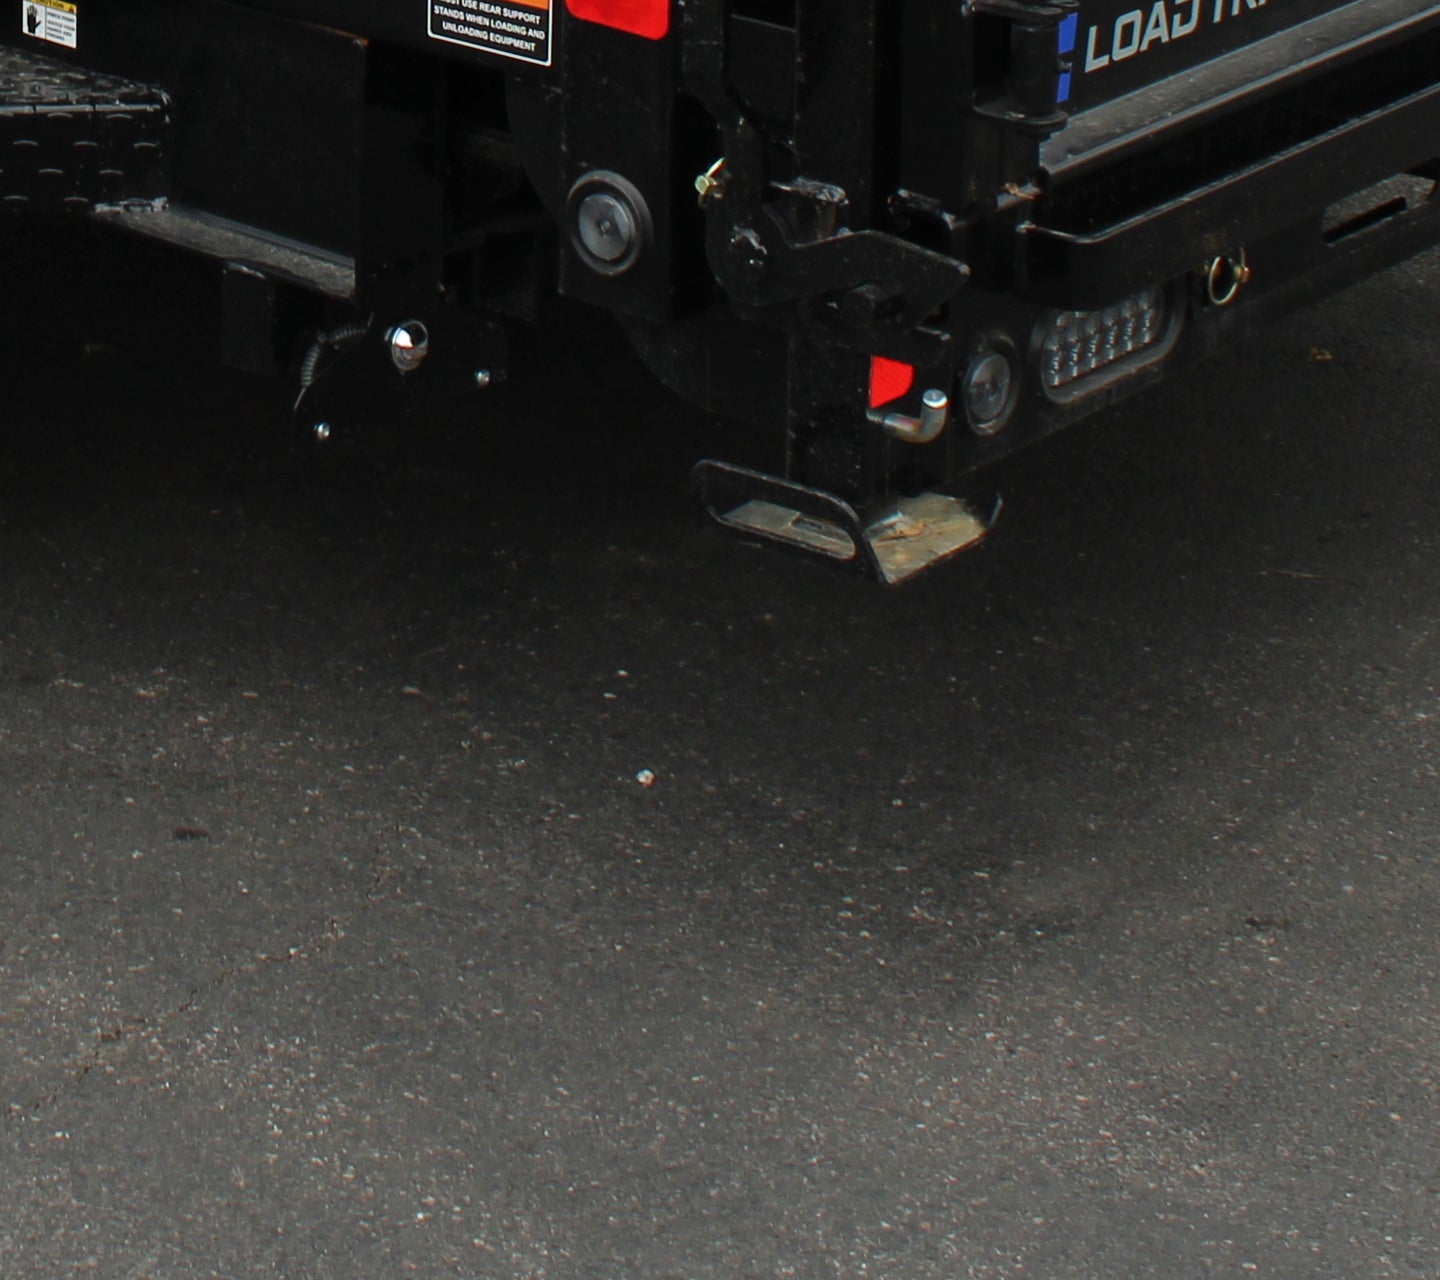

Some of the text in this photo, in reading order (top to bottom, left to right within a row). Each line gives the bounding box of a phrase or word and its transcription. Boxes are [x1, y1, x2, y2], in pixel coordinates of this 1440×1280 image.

[434, 5, 546, 40] STANDS WHEN LOADING AND
[479, 1, 501, 15] REAR
[502, 8, 541, 25] SUPPORT
[442, 21, 536, 52] UNLOADING EQUIPMENT
